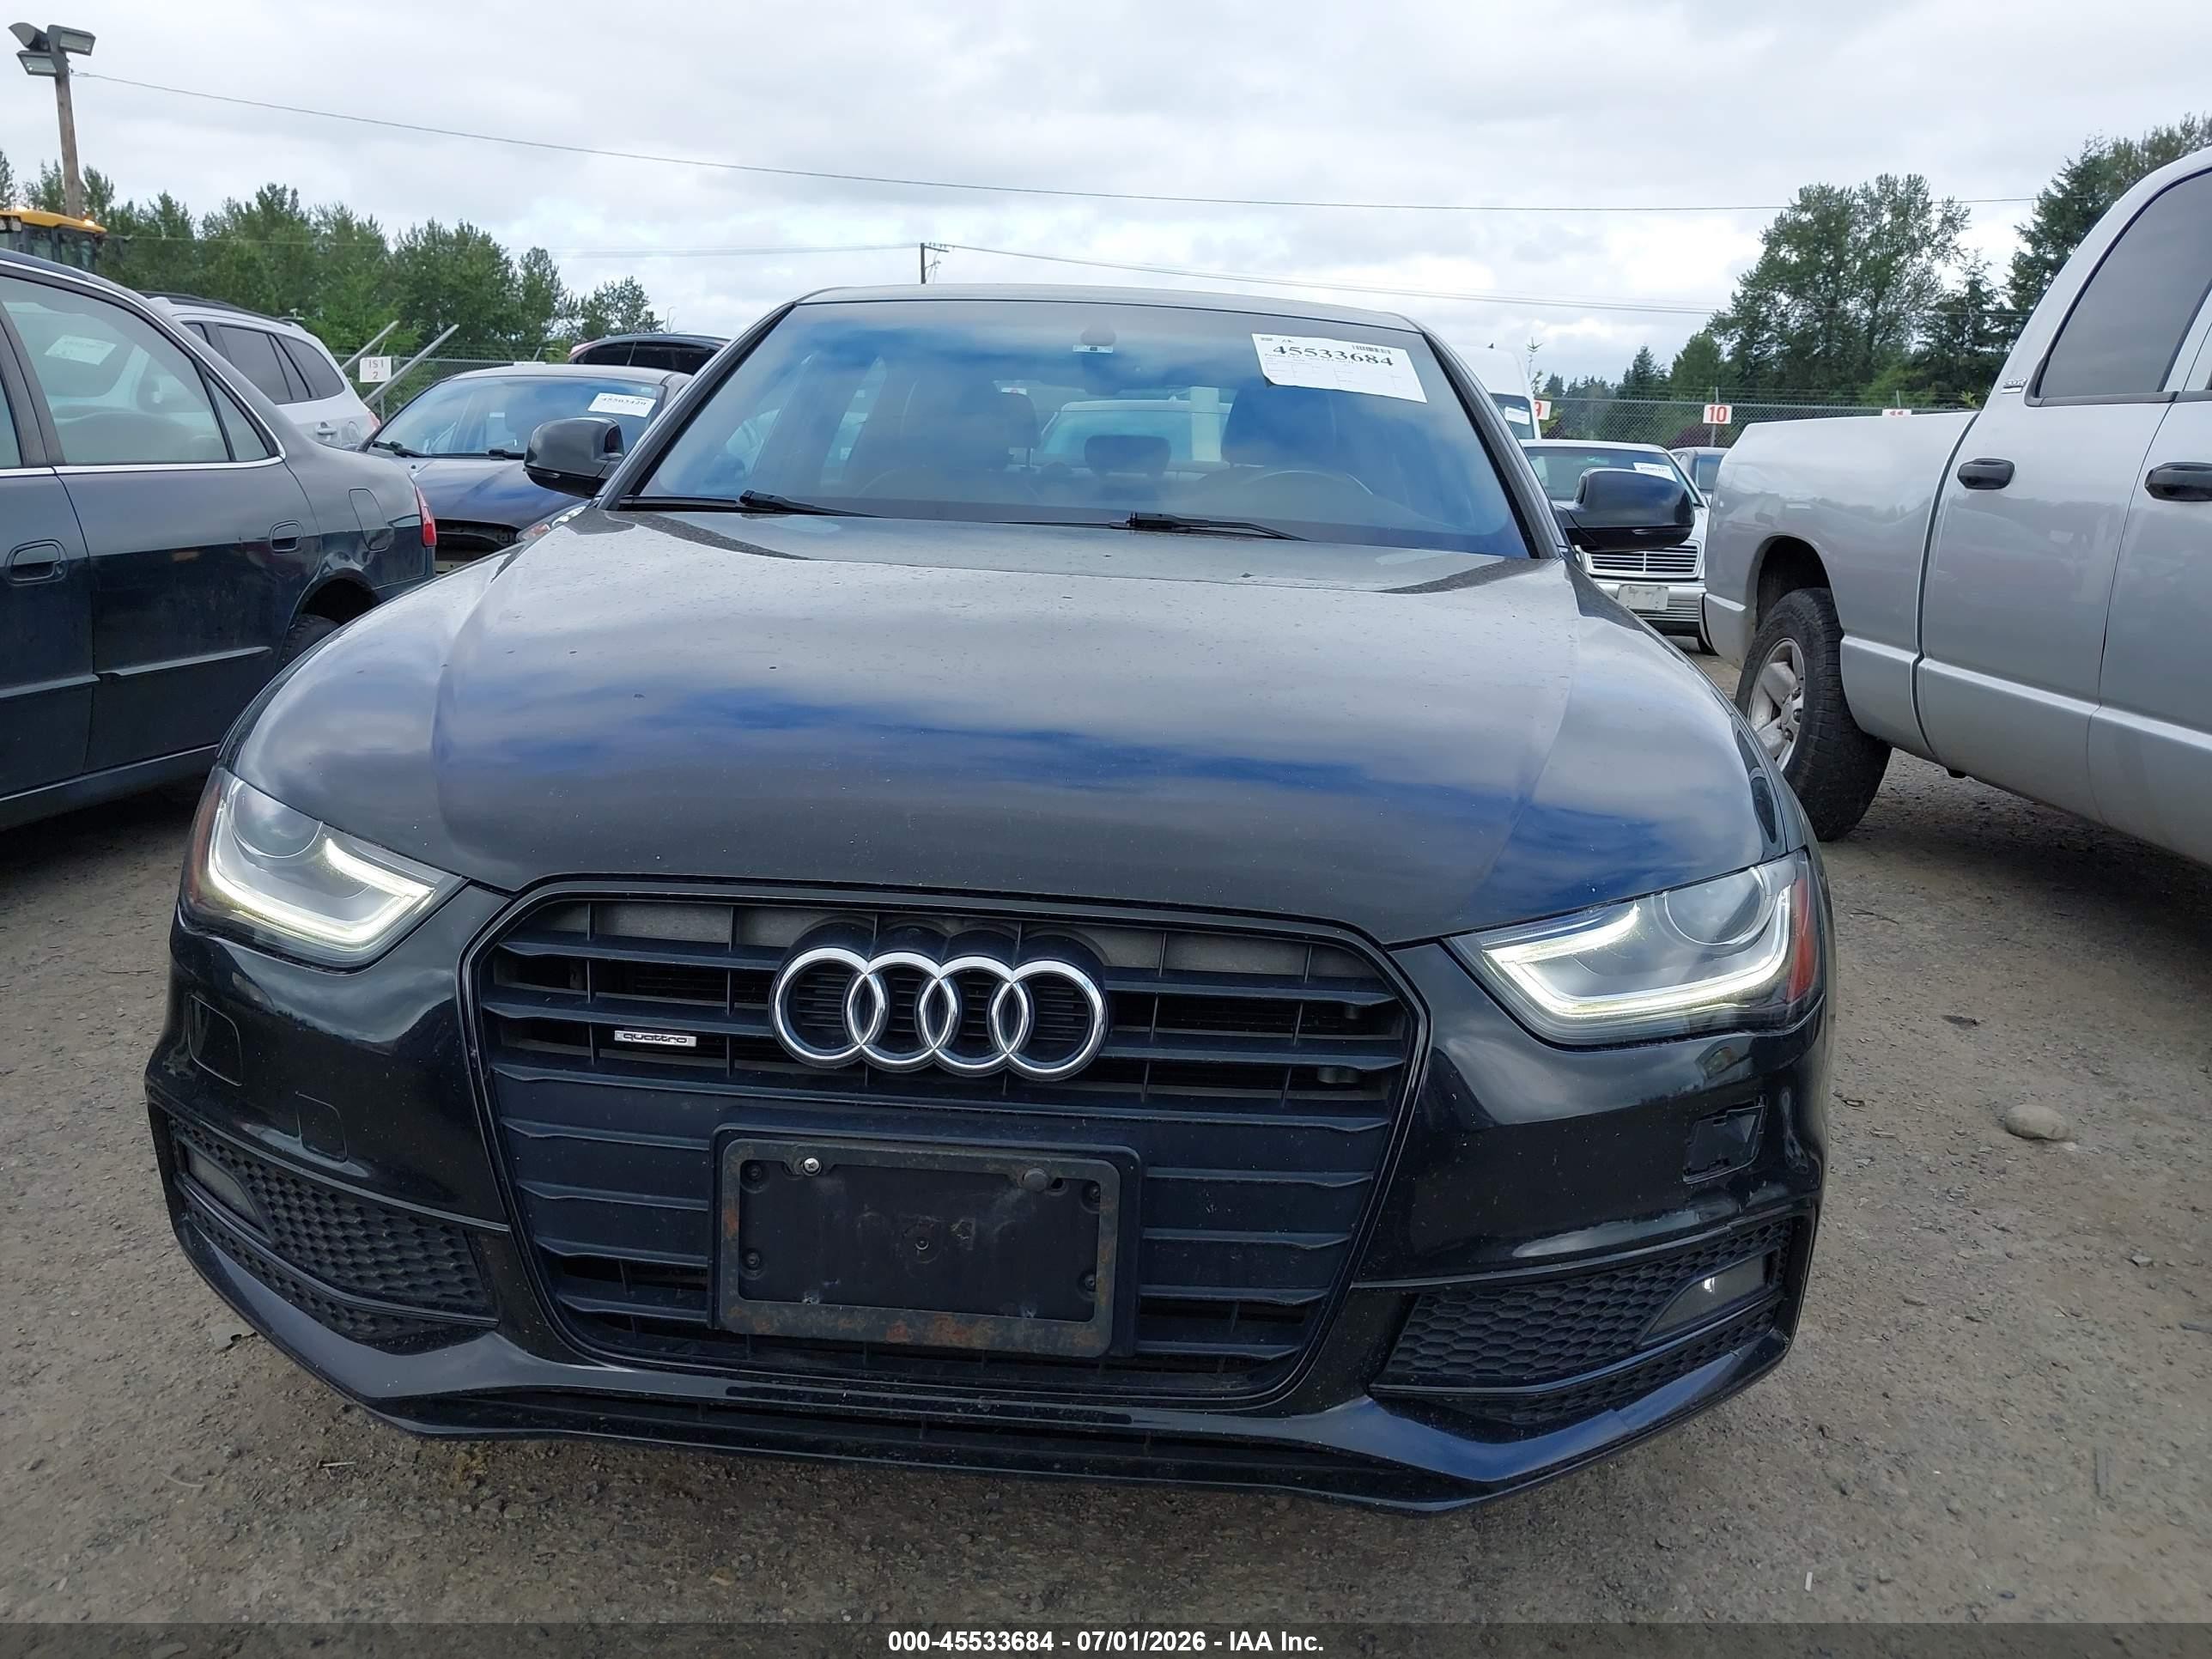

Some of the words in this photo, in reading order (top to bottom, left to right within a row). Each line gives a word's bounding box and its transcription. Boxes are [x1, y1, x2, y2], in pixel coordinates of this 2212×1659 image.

[1273, 345, 1395, 366] 45533684
[372, 371, 379, 380] 2
[1710, 406, 1727, 422] 10
[623, 1033, 688, 1044] quattro
